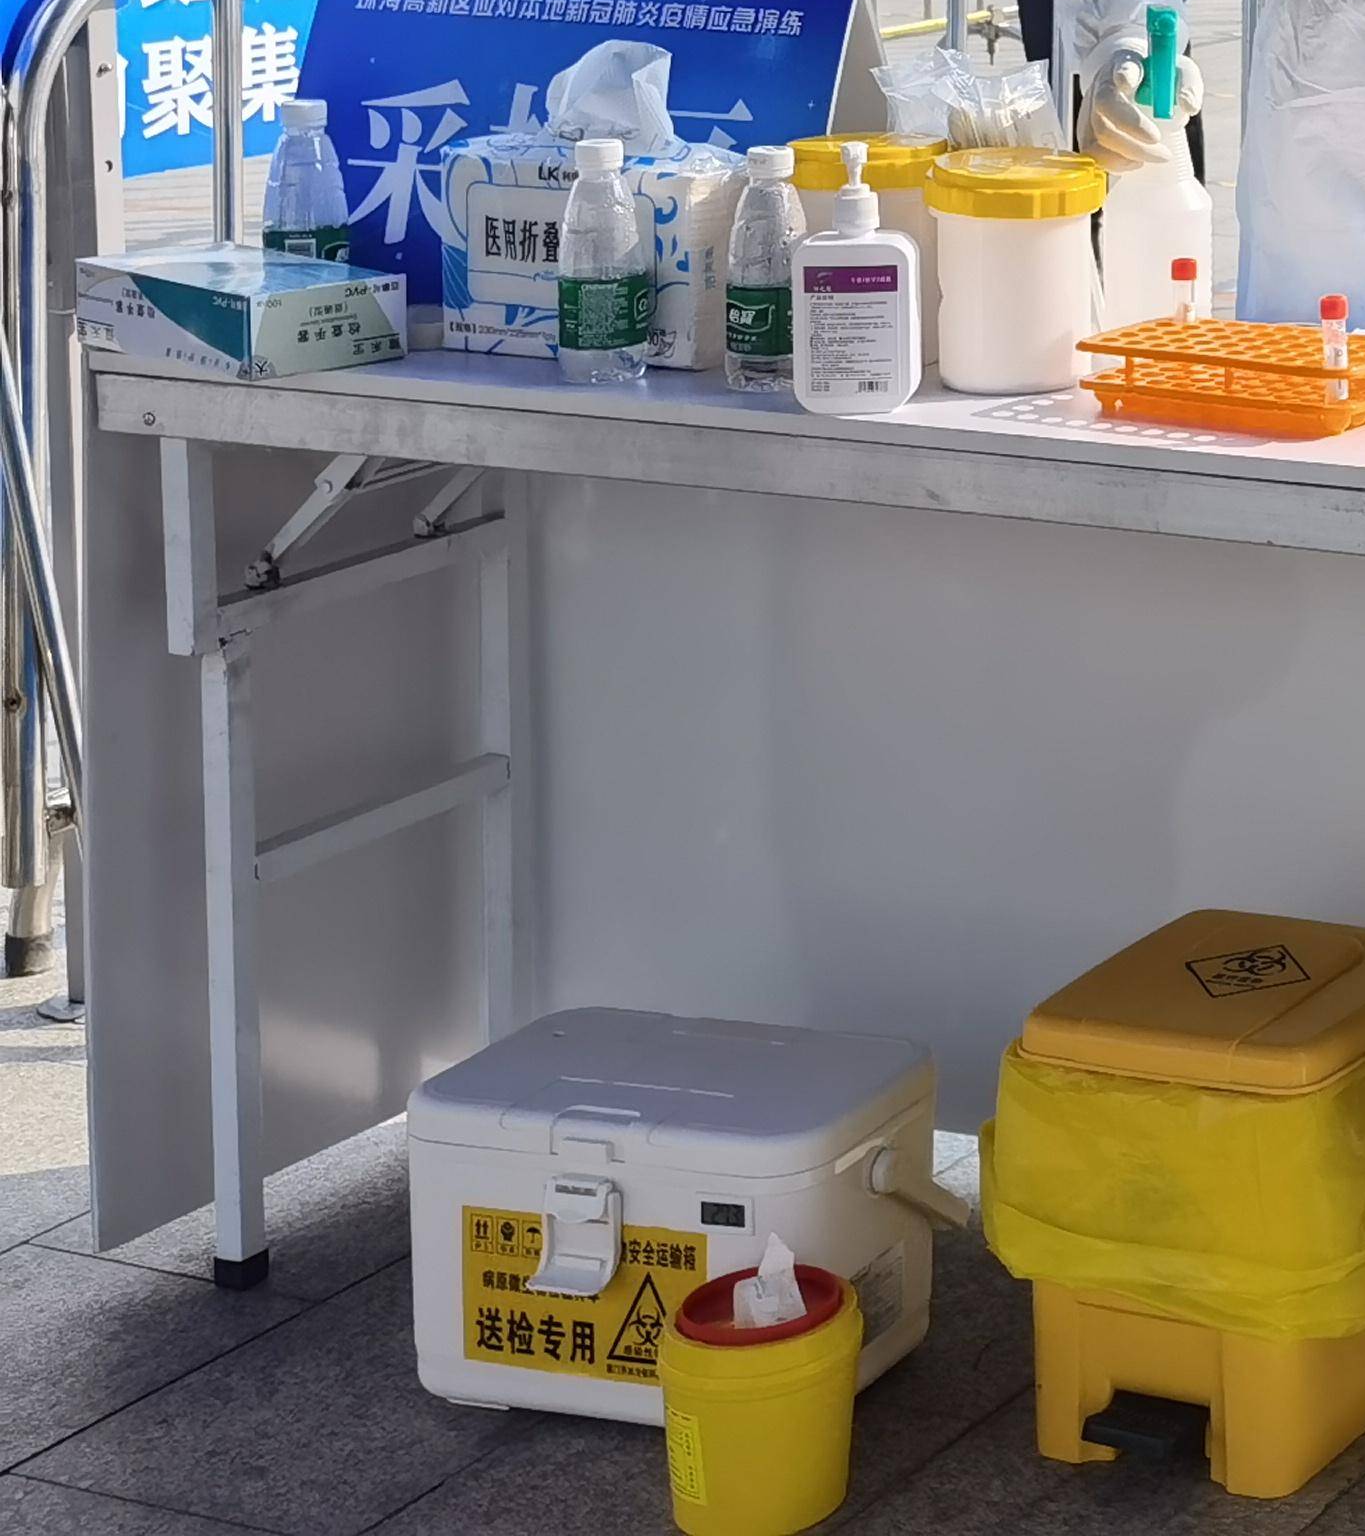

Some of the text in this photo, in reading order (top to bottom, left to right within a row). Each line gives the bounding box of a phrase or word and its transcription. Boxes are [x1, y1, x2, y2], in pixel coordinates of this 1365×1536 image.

[118, 22, 300, 140] 聚集
[476, 1308, 596, 1365] 送检专用
